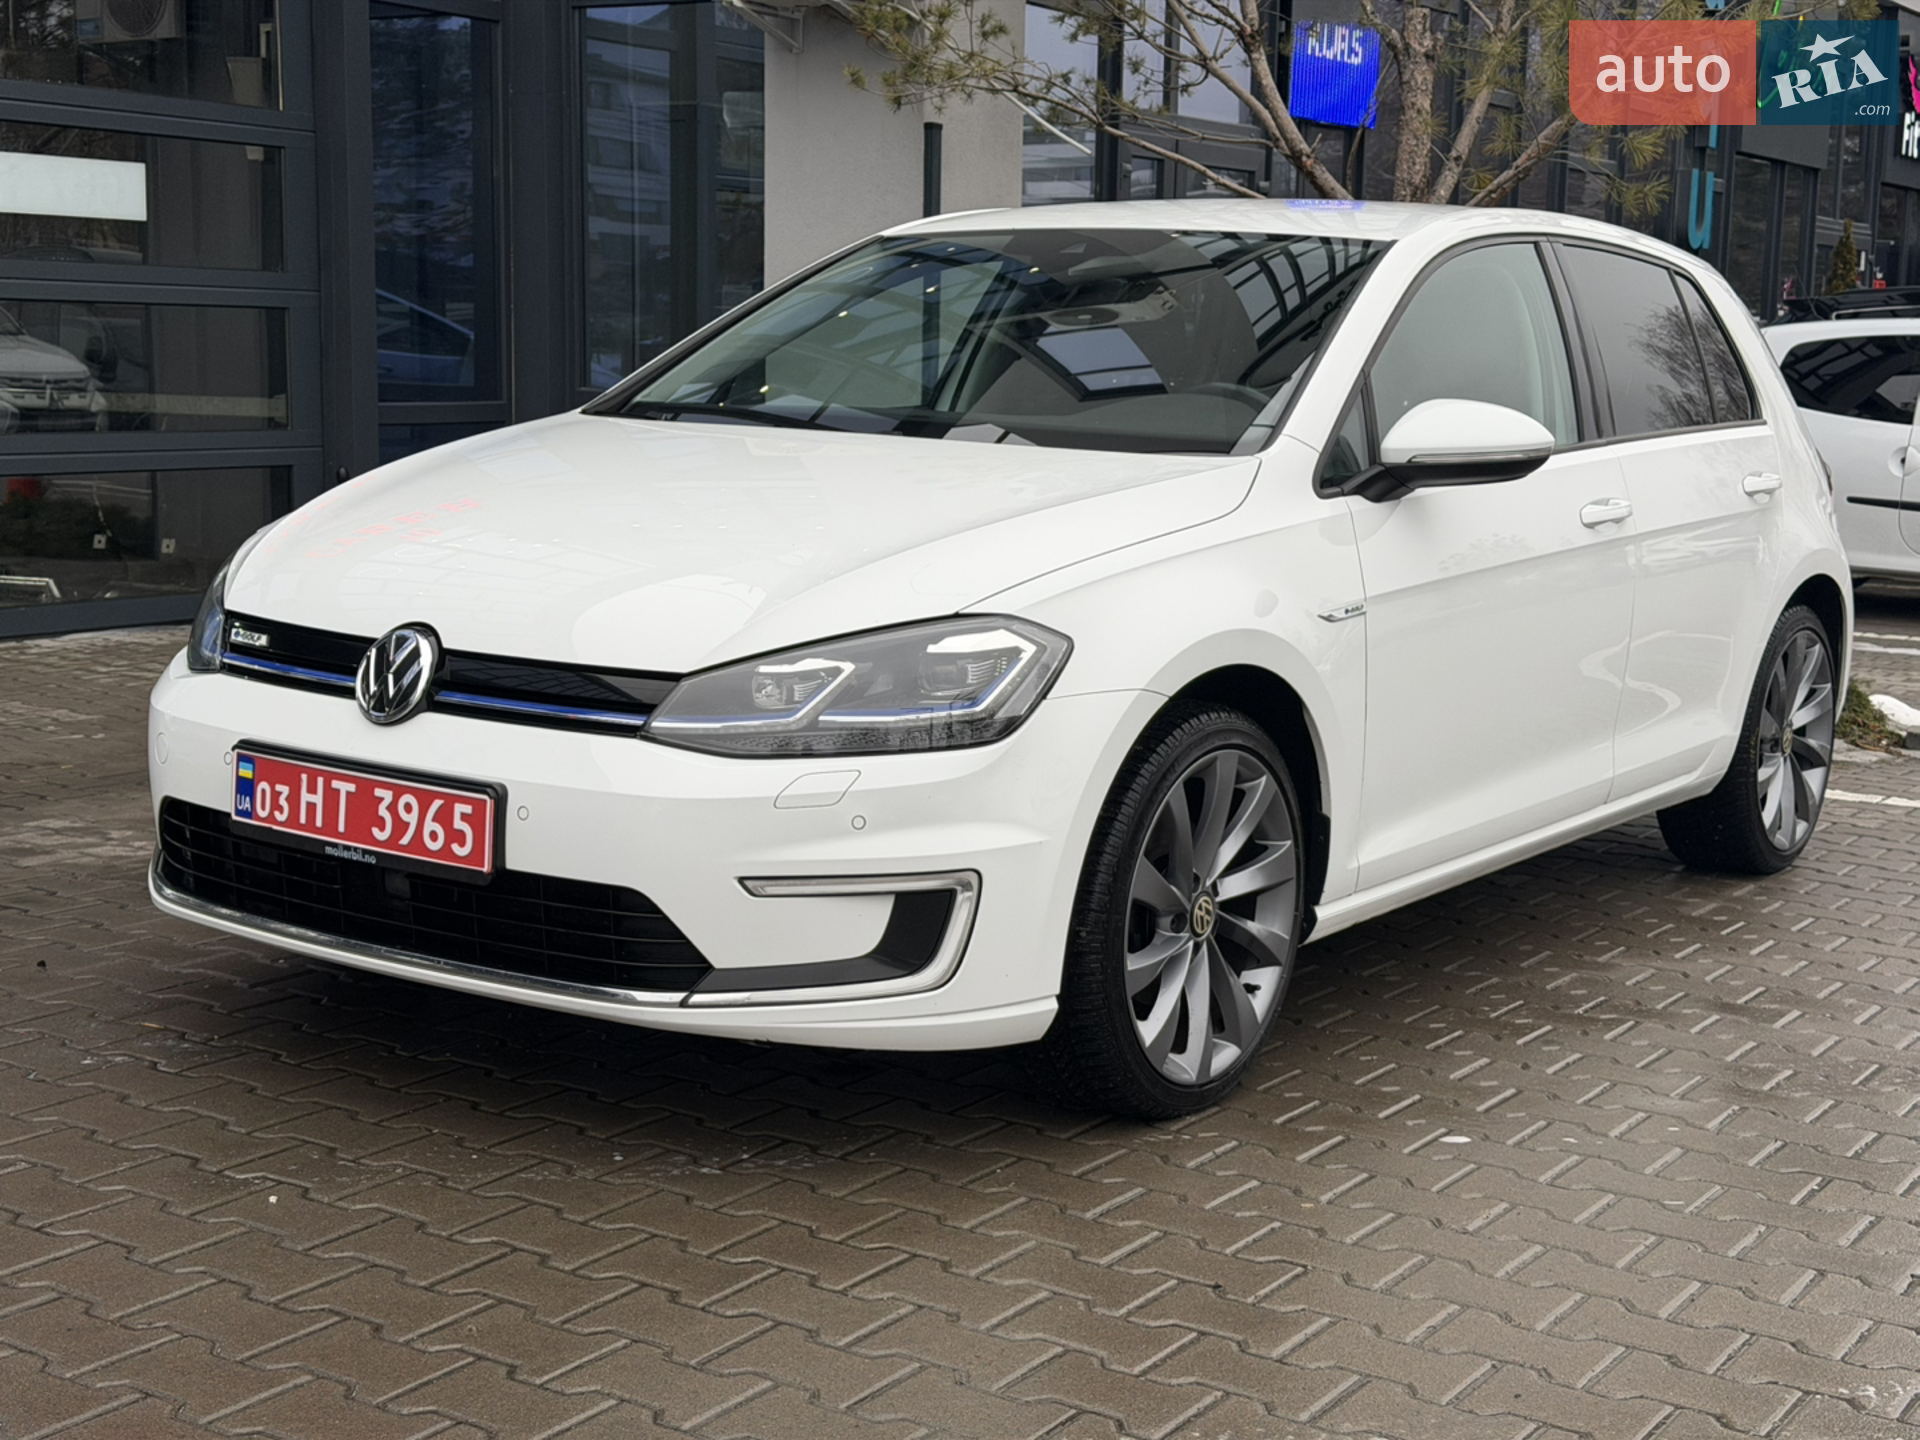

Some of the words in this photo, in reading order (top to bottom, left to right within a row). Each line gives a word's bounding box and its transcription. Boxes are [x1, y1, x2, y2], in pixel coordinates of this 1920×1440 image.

[236, 794, 252, 813] UA
[255, 781, 290, 823] 03
[299, 773, 356, 834] HT
[371, 787, 474, 858] 3965
